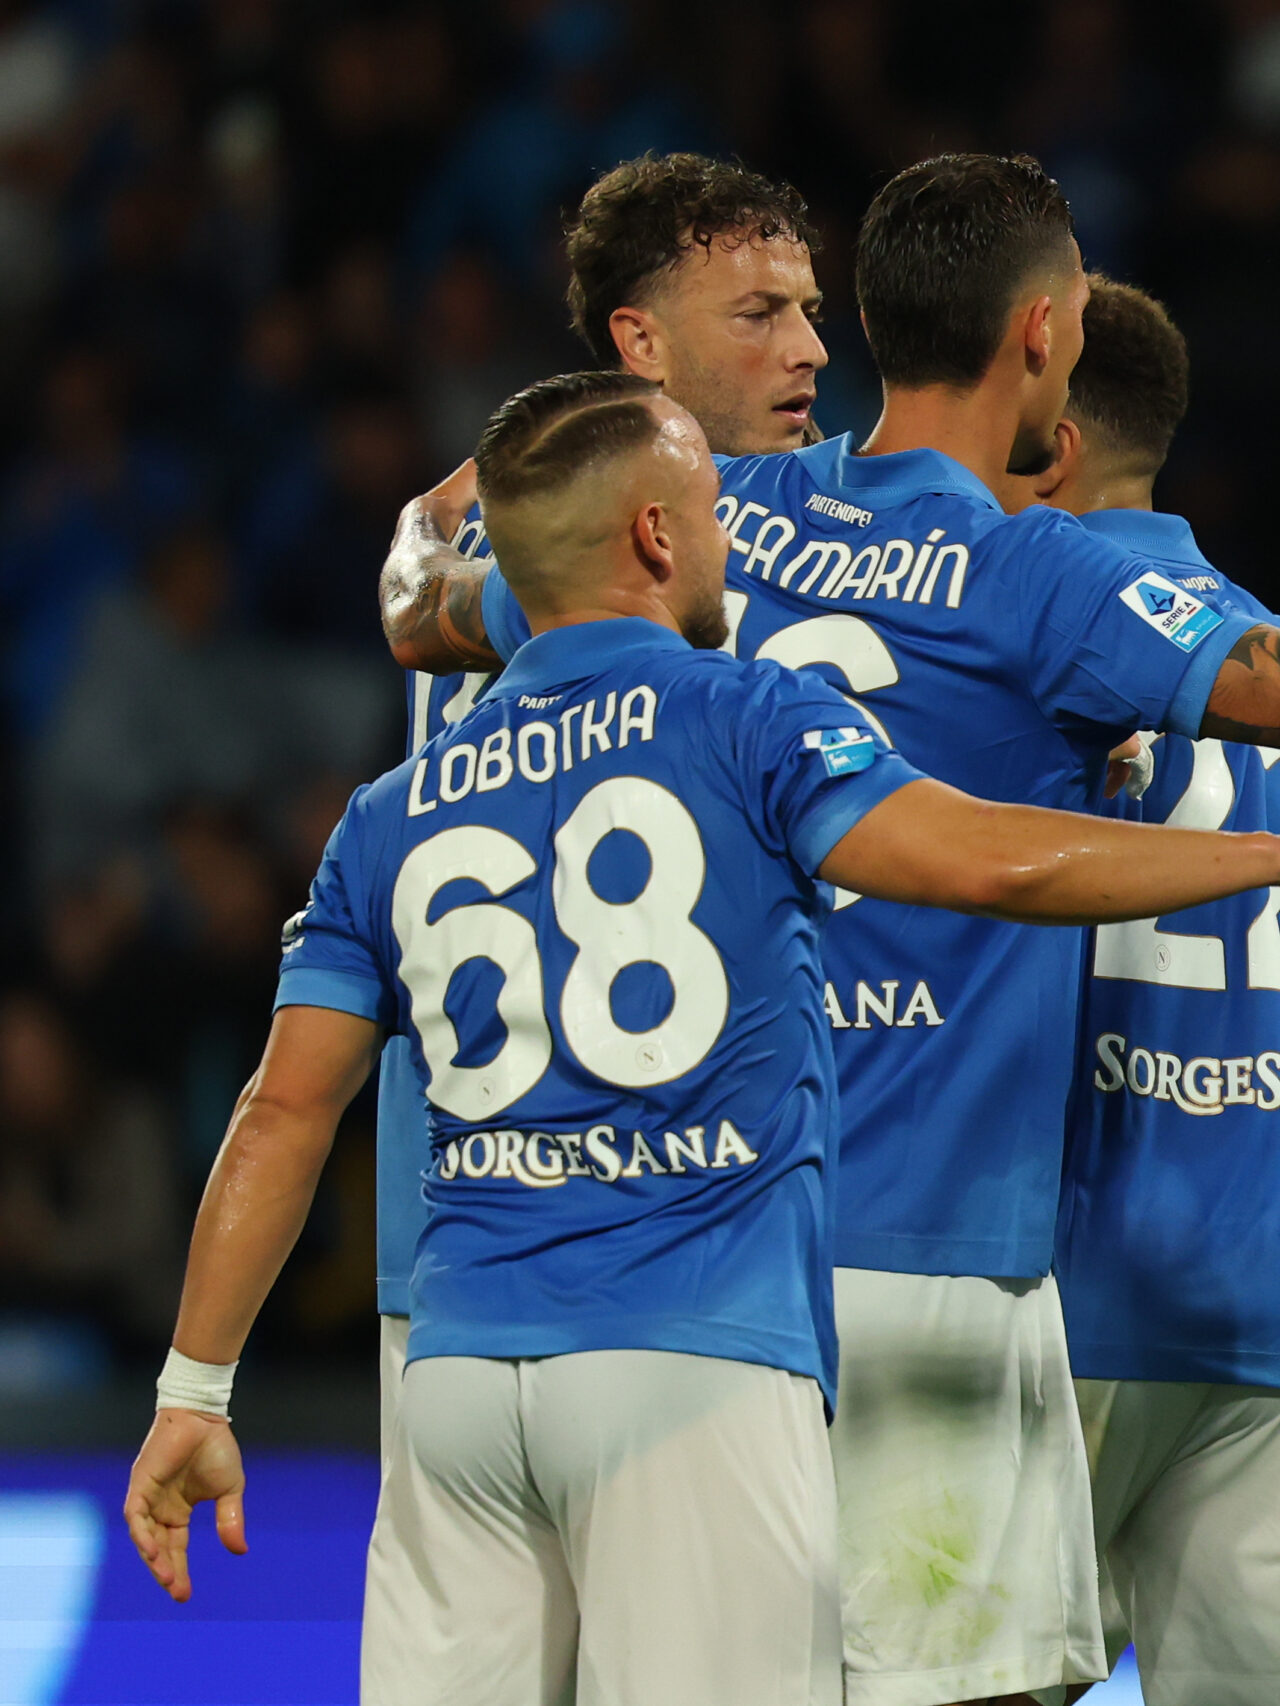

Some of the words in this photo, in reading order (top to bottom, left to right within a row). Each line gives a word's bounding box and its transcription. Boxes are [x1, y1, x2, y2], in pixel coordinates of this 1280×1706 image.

[778, 528, 969, 609] MARÍN
[1162, 607, 1186, 629] SERIE
[1184, 601, 1193, 613] A
[408, 684, 656, 817] LOBOTKA
[392, 775, 729, 1121] 68
